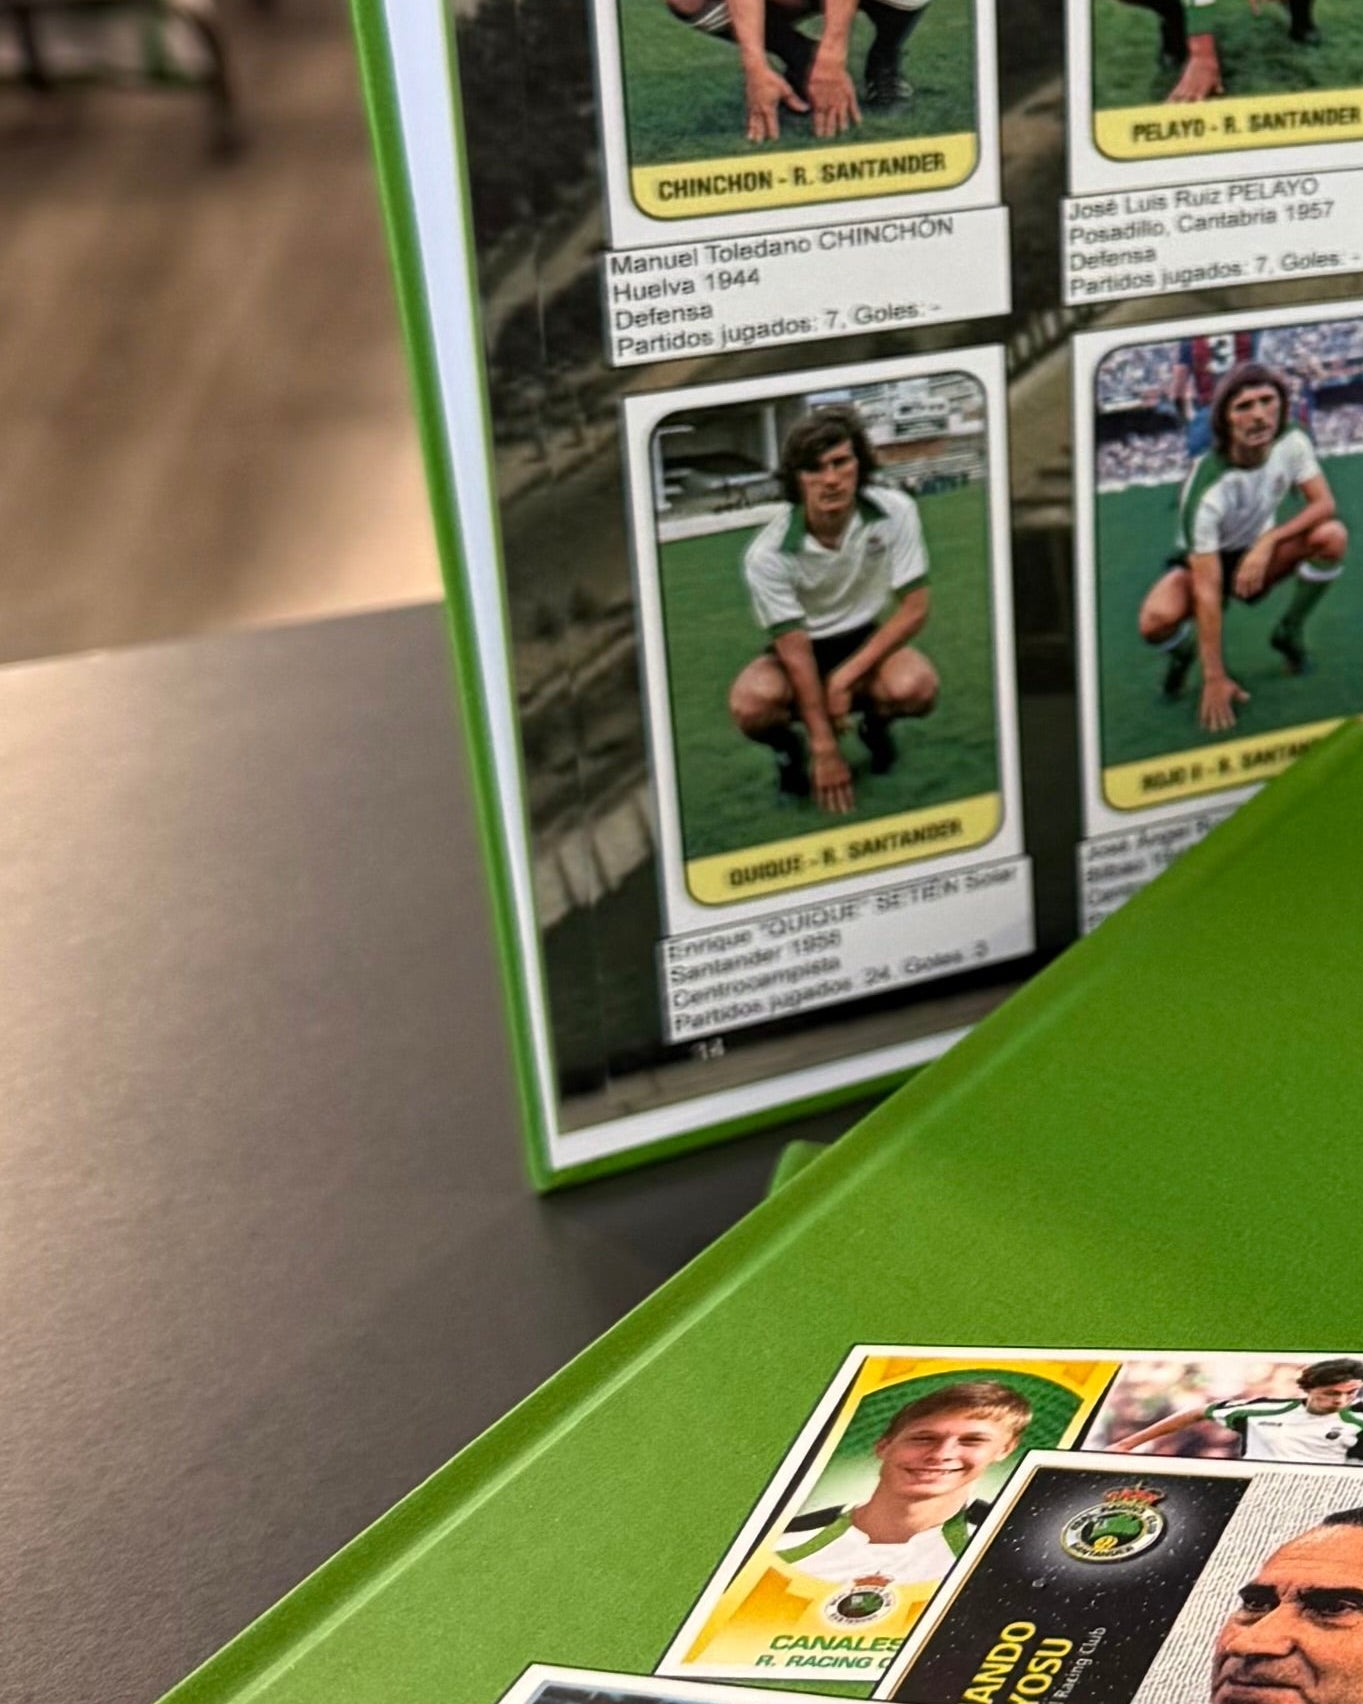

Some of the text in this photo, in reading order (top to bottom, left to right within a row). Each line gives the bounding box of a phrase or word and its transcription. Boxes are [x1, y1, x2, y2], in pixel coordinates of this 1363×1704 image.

[658, 152, 947, 202] CHINCHON R. SANTANDER
[611, 216, 954, 277] Manuel Toledano CHINCHÓN
[615, 304, 714, 331] Defensa
[770, 1635, 904, 1652] CANALES
[1079, 1627, 1106, 1655] Club
[755, 1655, 778, 1667] R.
[781, 1655, 871, 1669] RACING
